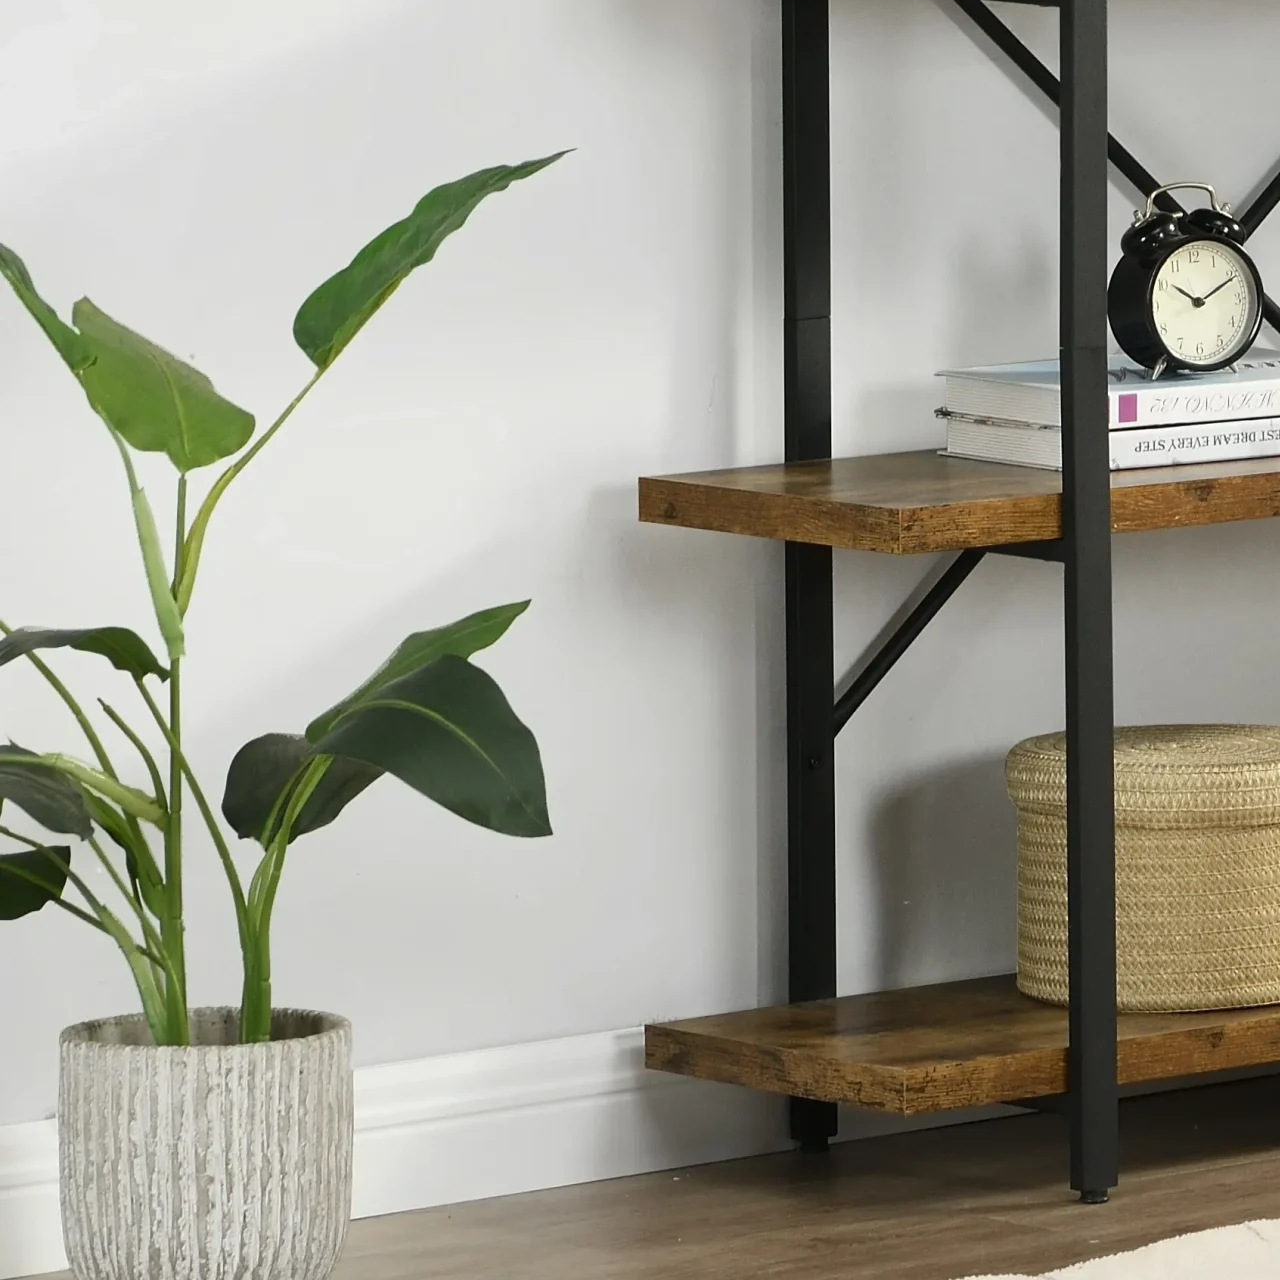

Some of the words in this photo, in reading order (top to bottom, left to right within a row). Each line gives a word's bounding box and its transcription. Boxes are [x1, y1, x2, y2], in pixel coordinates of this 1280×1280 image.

[1188, 250, 1200, 264] 12
[1211, 255, 1216, 268] 1
[1171, 260, 1180, 273] 11
[1158, 279, 1169, 292] 10
[1234, 292, 1241, 306] 3
[1228, 315, 1235, 328] 4
[1160, 323, 1168, 336] 8
[1177, 337, 1184, 350] 7
[1216, 335, 1224, 347] 5
[1196, 342, 1204, 355] 6
[1168, 435, 1210, 452] EVERY
[1213, 431, 1257, 446] DREAM
[1134, 439, 1166, 453] STEP
